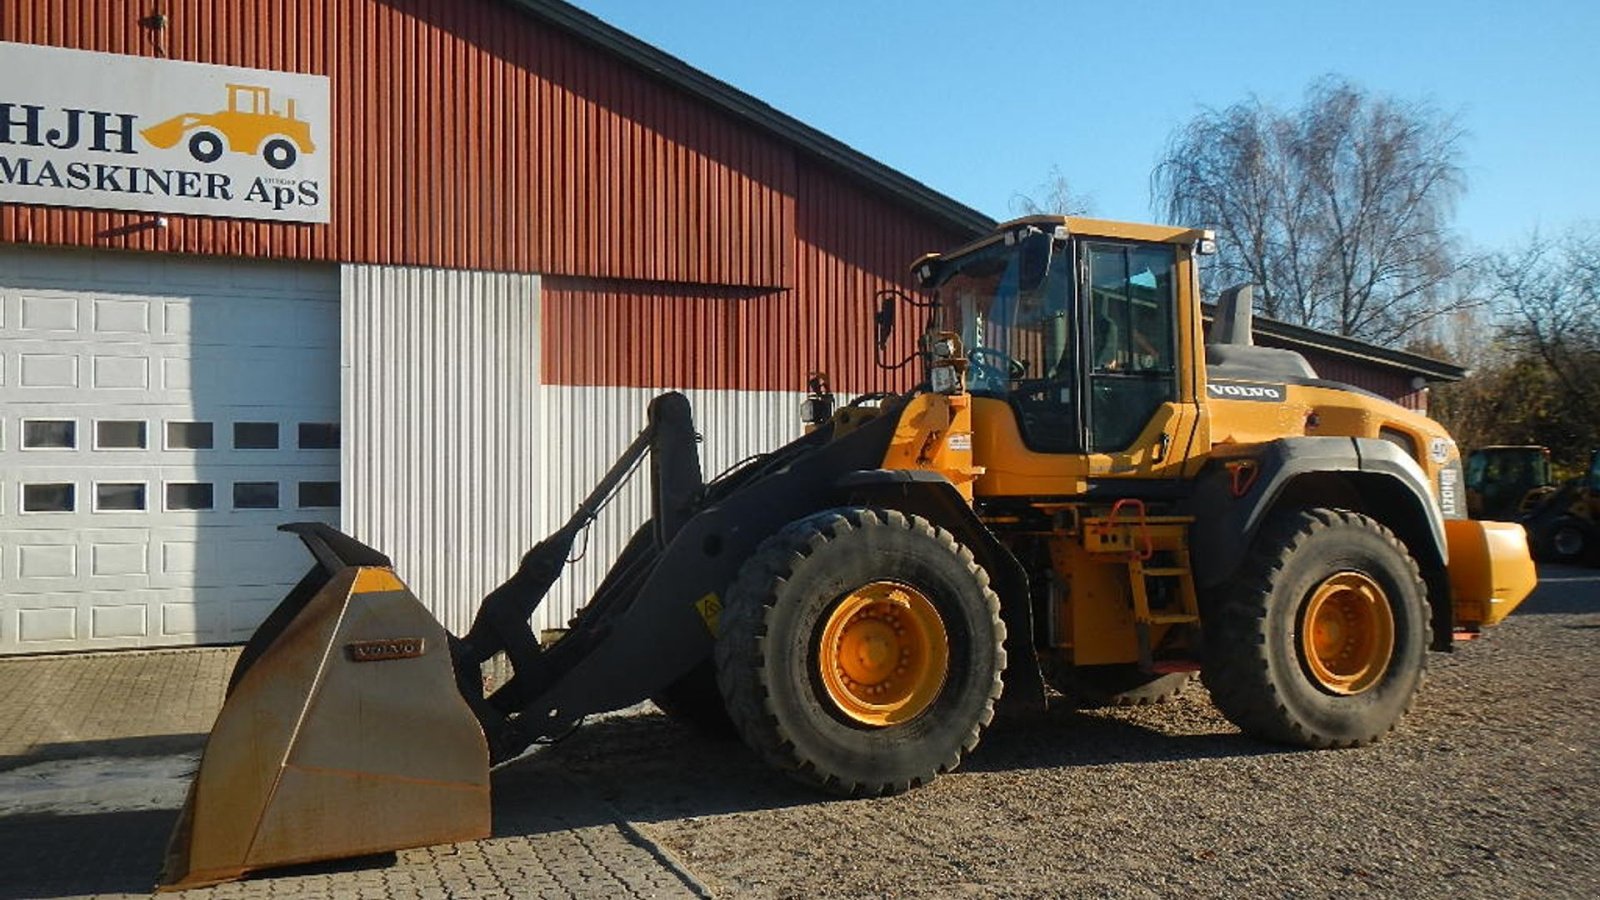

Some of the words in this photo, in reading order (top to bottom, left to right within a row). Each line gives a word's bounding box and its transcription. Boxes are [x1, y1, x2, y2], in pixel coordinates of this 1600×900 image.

[0, 103, 138, 154] HJH
[0, 156, 233, 200] MASKINER
[244, 176, 319, 210] ApS
[1206, 384, 1279, 398] VOLVO
[357, 644, 415, 656] VOLVO
